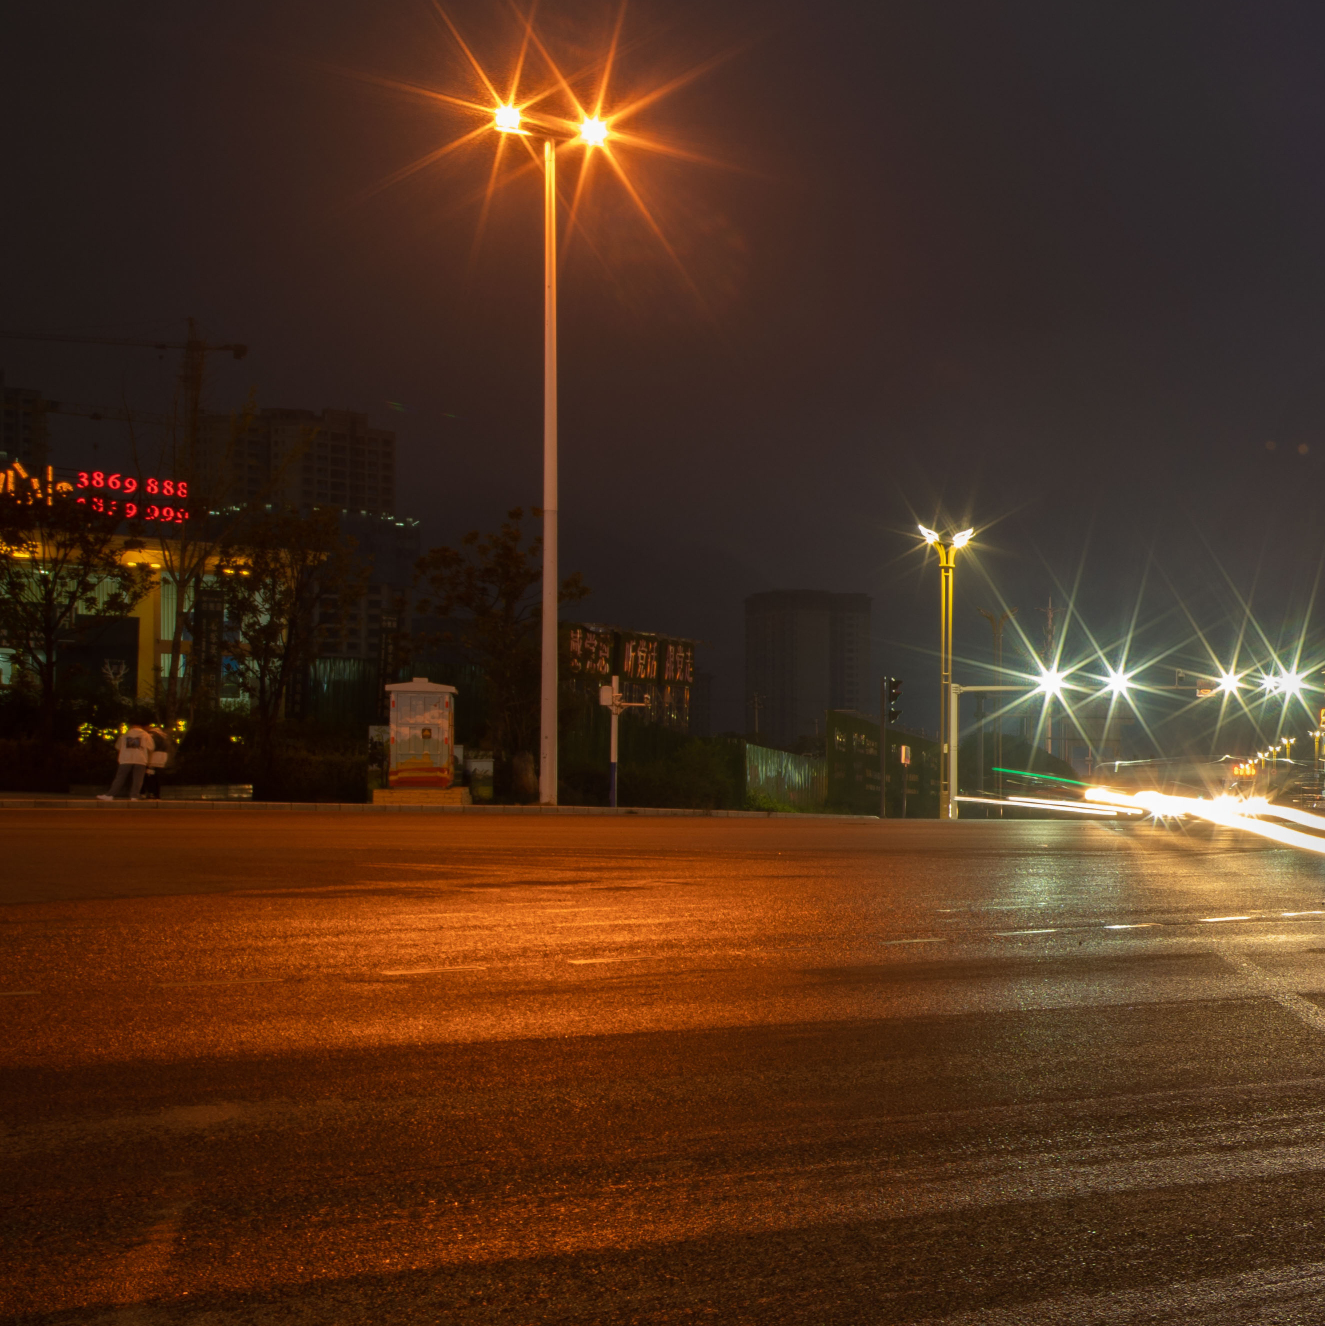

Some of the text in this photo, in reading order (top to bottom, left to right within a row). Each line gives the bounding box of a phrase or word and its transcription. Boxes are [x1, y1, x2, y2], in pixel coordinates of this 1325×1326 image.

[77, 471, 138, 494] 3869
[146, 477, 188, 498] 888
[623, 639, 657, 679] 听党话
[664, 644, 694, 683] 跟党走
